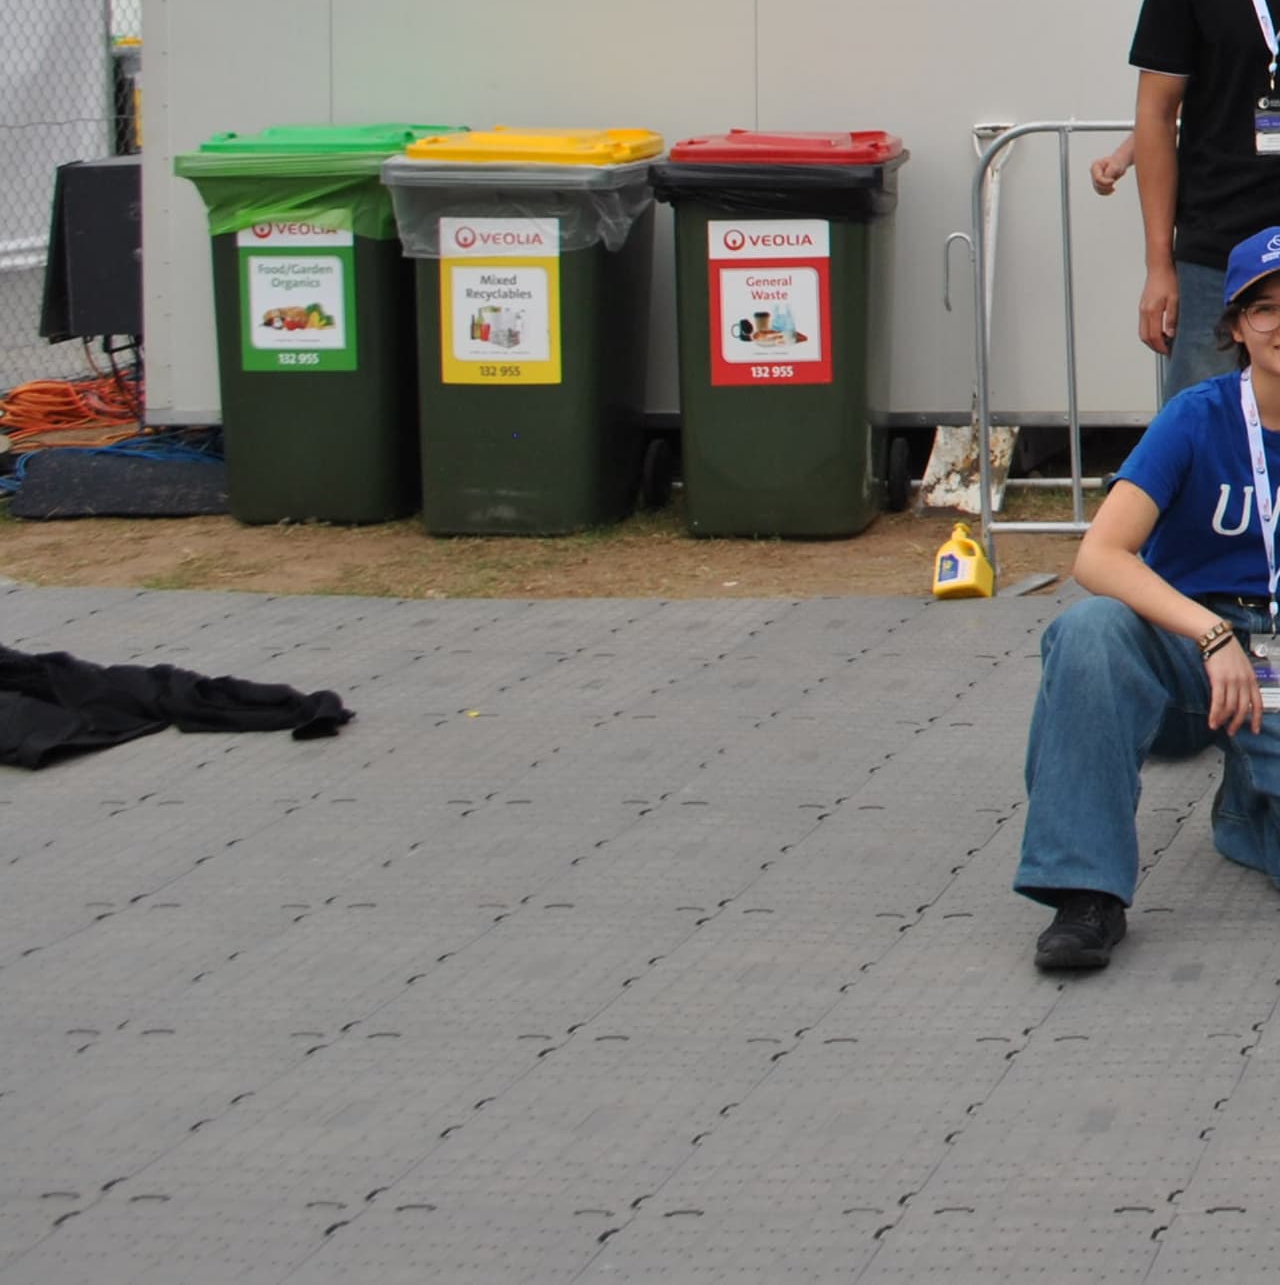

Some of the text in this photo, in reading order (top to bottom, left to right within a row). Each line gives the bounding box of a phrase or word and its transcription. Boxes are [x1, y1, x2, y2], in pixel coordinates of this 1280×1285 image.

[480, 232, 544, 245] VEOLIA
[750, 234, 813, 247] VEOLIA
[258, 263, 334, 275] Food/Garden
[271, 277, 321, 290] Organics
[480, 274, 517, 286] Mixed
[746, 276, 792, 287] General
[466, 288, 532, 301] Recyclables
[751, 290, 788, 300] Waste
[278, 352, 319, 364] 132 955
[480, 366, 520, 377] 132 955
[751, 366, 793, 378] 132 955
